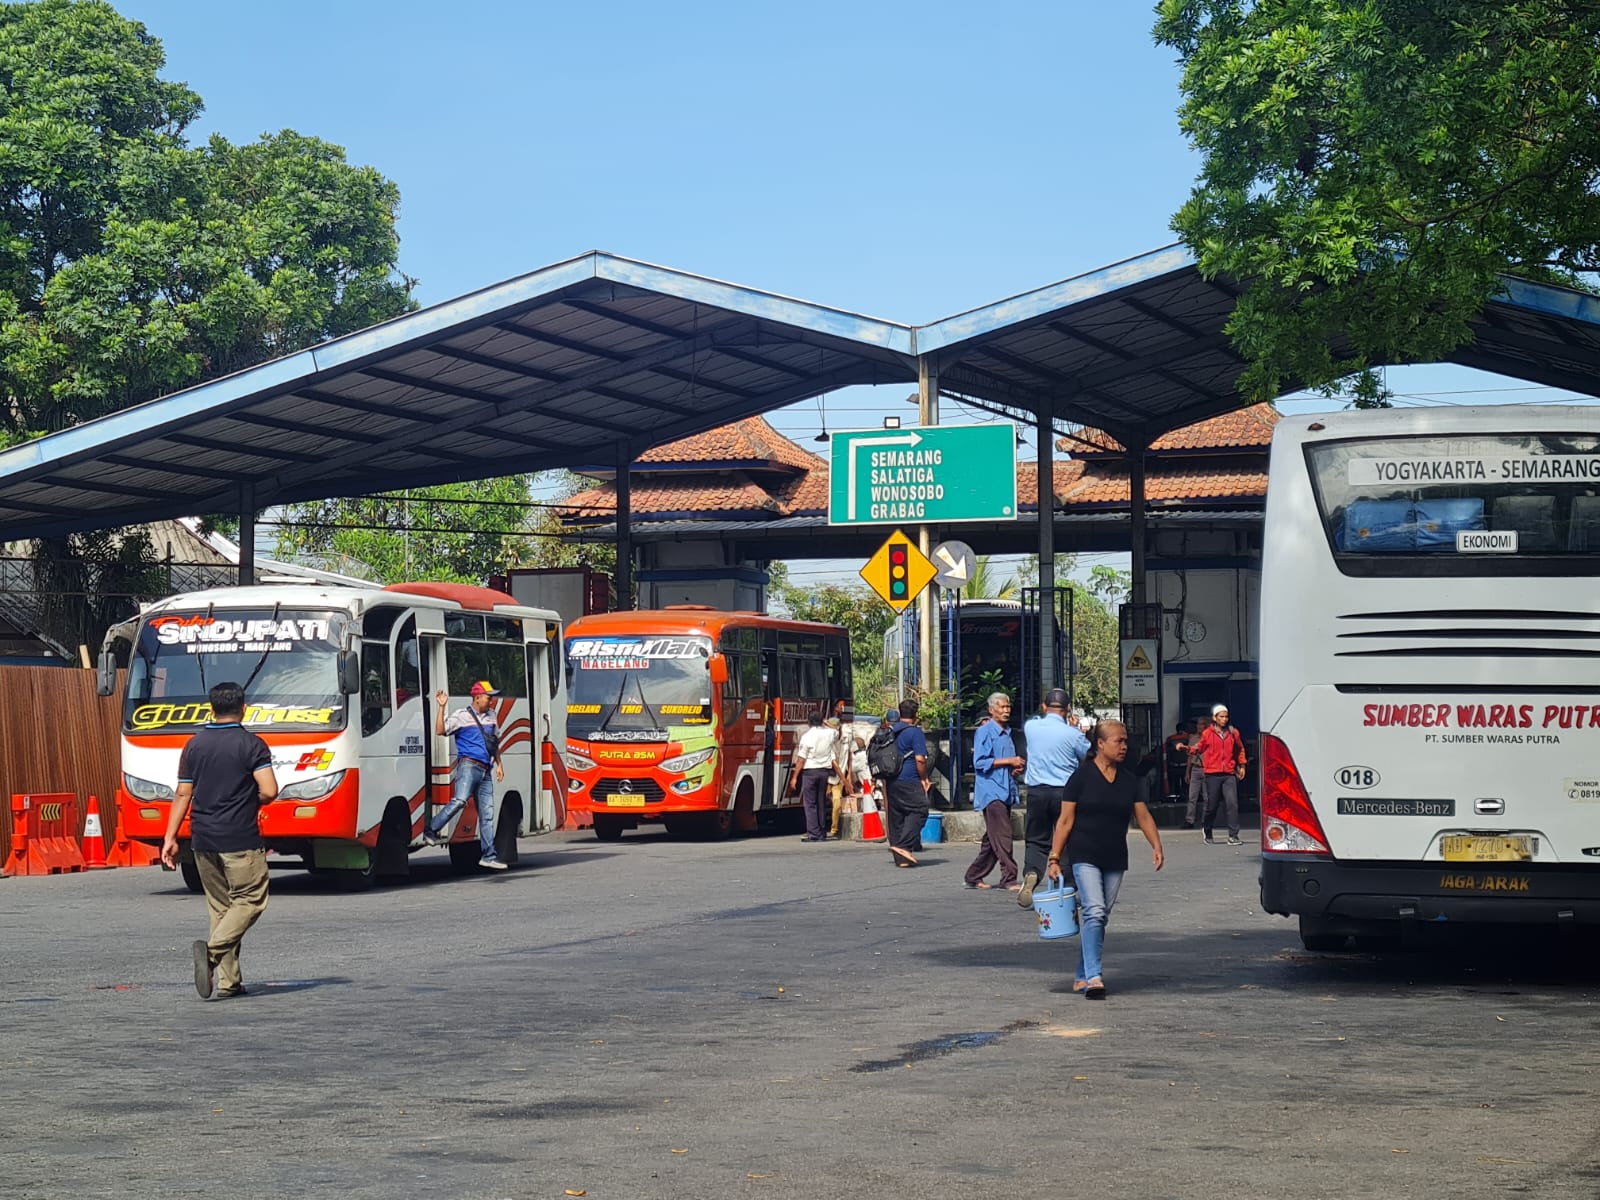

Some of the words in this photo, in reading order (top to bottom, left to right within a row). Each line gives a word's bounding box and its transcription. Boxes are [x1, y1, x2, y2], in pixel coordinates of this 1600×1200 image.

[871, 449, 942, 467] SEMARANG
[871, 467, 934, 485] SALATIGA
[1376, 460, 1486, 480] YOGYAKARTA
[1501, 458, 1600, 479] SEMARANG
[871, 484, 944, 502] WONOSOBO
[870, 502, 925, 519] GRABAG
[1463, 535, 1512, 548] EKONOMI
[582, 659, 648, 669] MAGELANG
[1363, 704, 1451, 727] SUMBER
[1457, 705, 1534, 728] WARAS
[1425, 735, 1439, 743] PT.
[1442, 735, 1484, 743] SUMBER
[1487, 735, 1523, 744] WARAS
[1526, 735, 1560, 744] PUTRA
[600, 751, 631, 759] PUTRA
[1341, 770, 1374, 785] 018
[1343, 801, 1450, 815] Mercedes-Benz
